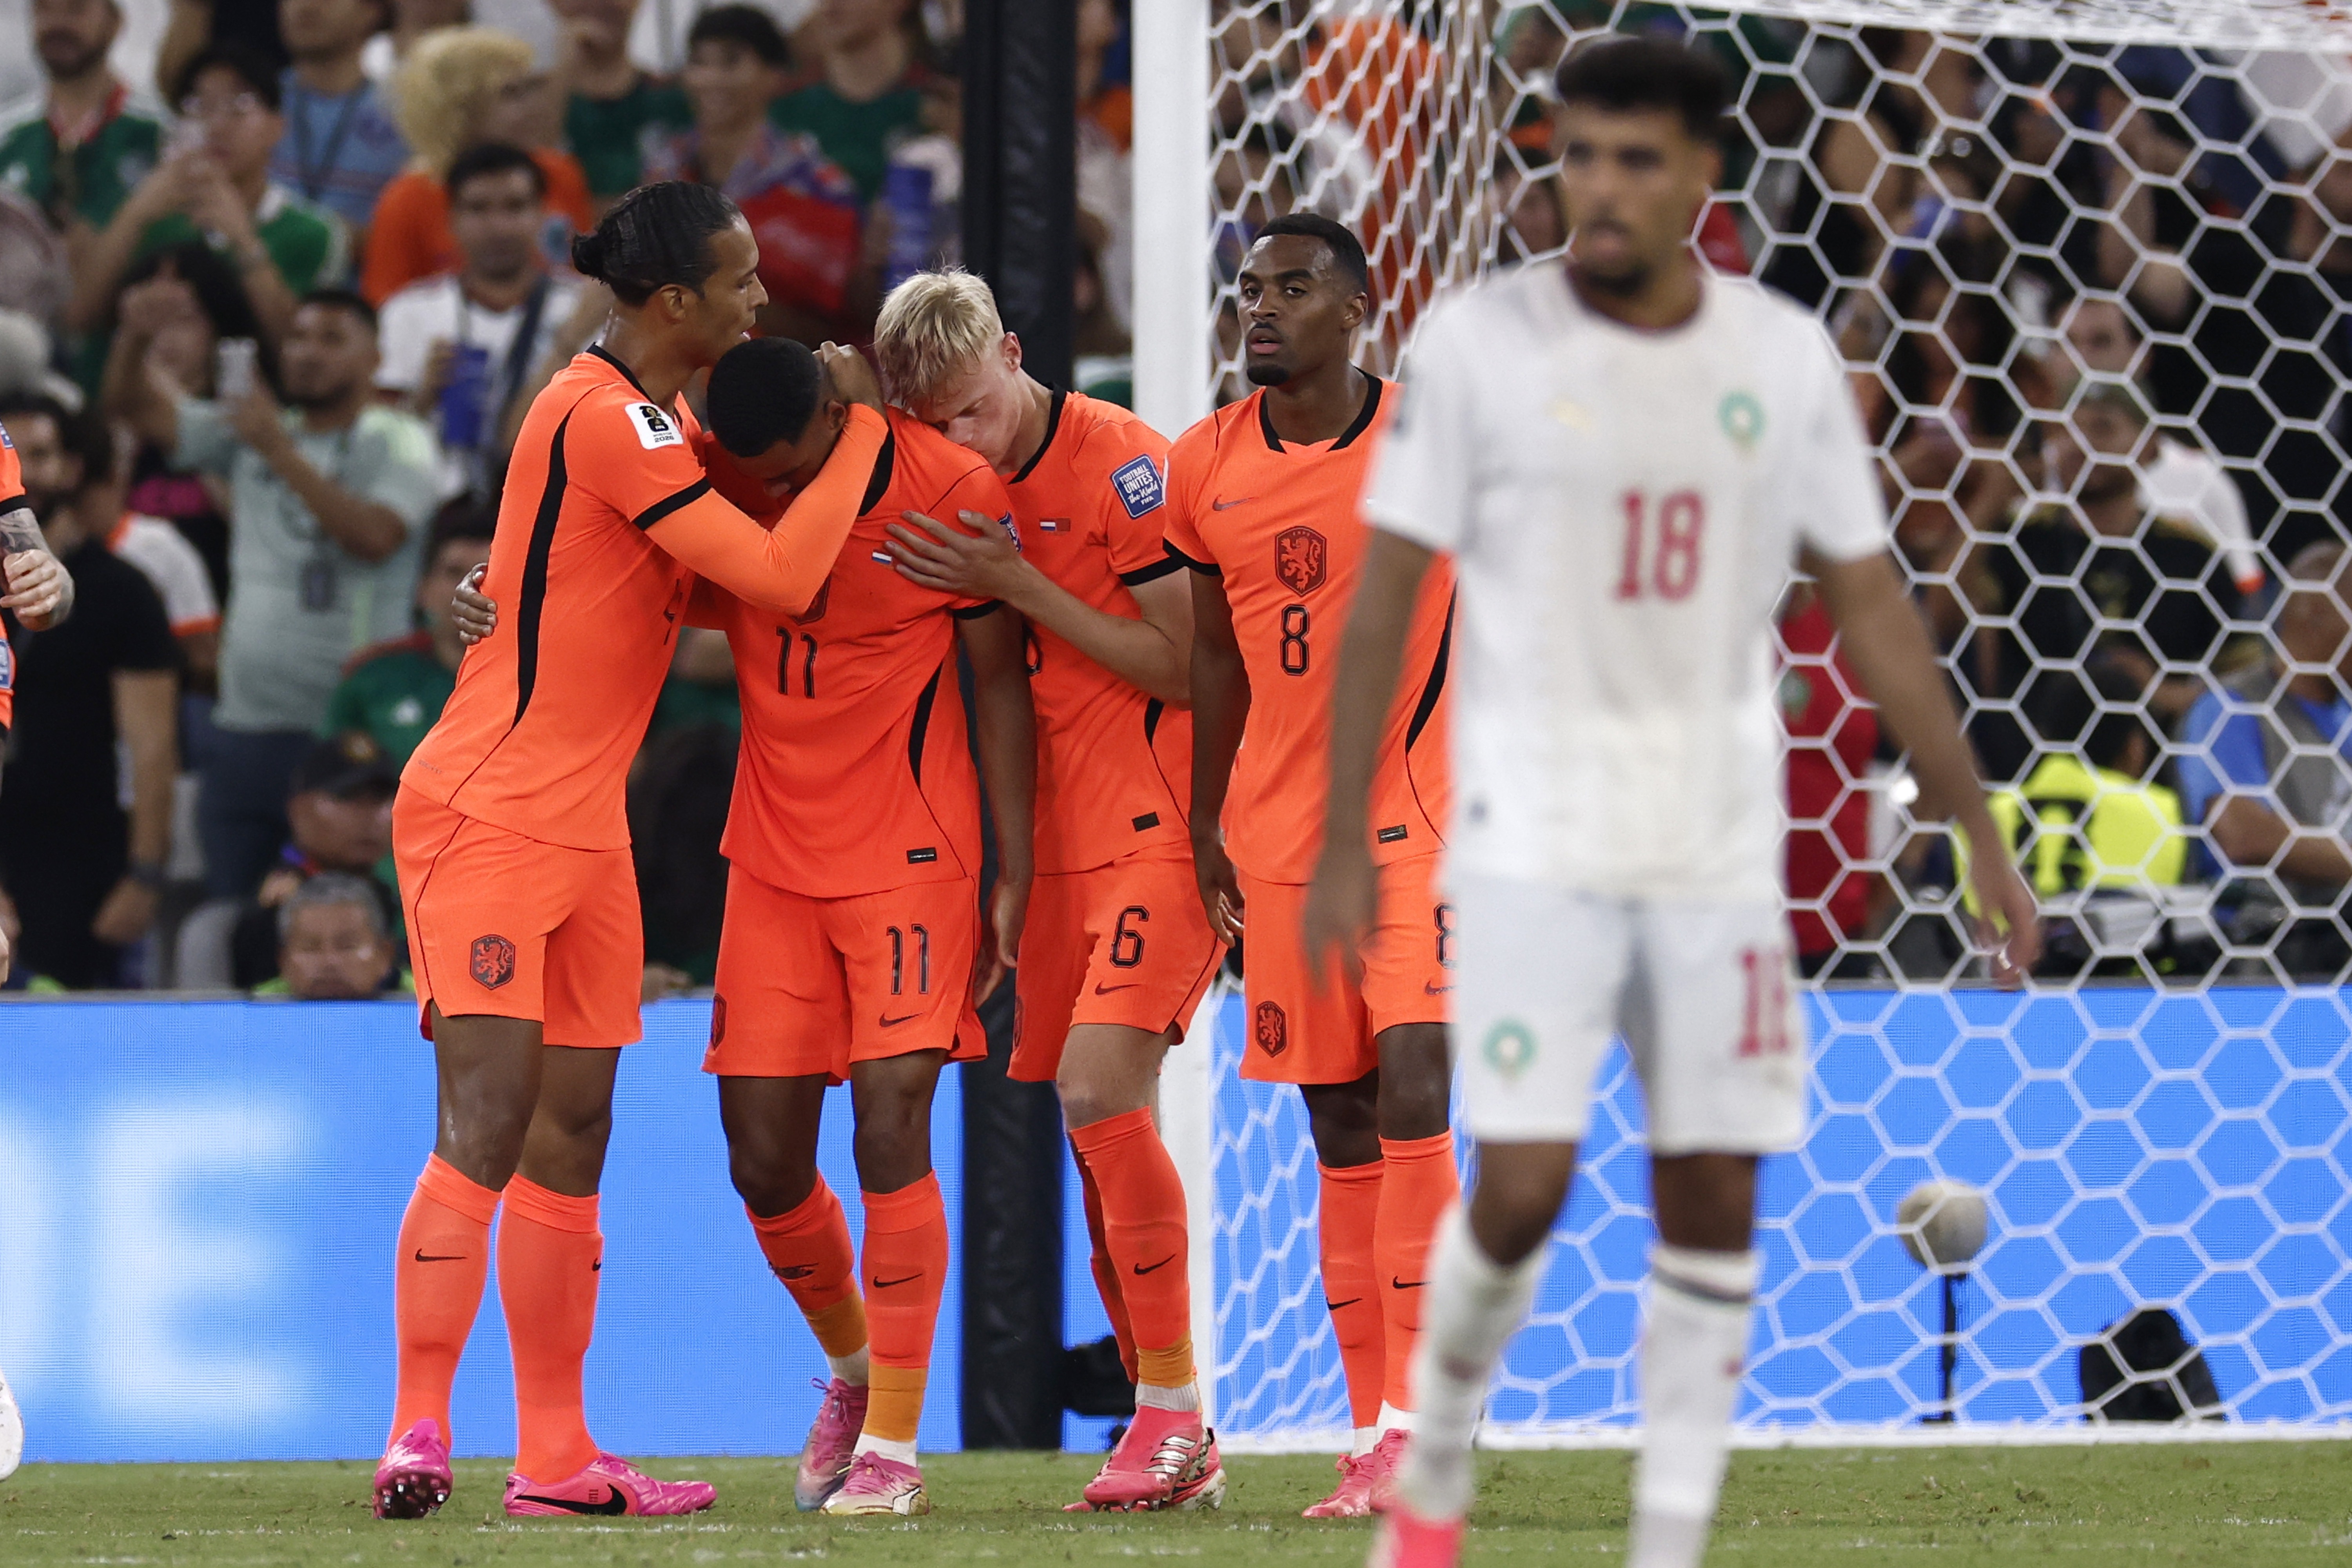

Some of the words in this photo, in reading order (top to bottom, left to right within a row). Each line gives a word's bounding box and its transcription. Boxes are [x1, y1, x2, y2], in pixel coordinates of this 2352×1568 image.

[1119, 464, 1149, 484] FOOTBALL
[1123, 472, 1153, 494] UNITES
[1128, 493, 1141, 504] the
[1138, 480, 1159, 498] World
[1141, 495, 1154, 505] FIFA
[1614, 489, 1704, 602] 18
[777, 626, 818, 699] 11
[1280, 604, 1310, 677] 8
[886, 924, 929, 995] 11
[1109, 906, 1149, 969] 6
[0, 1090, 304, 1417] E
